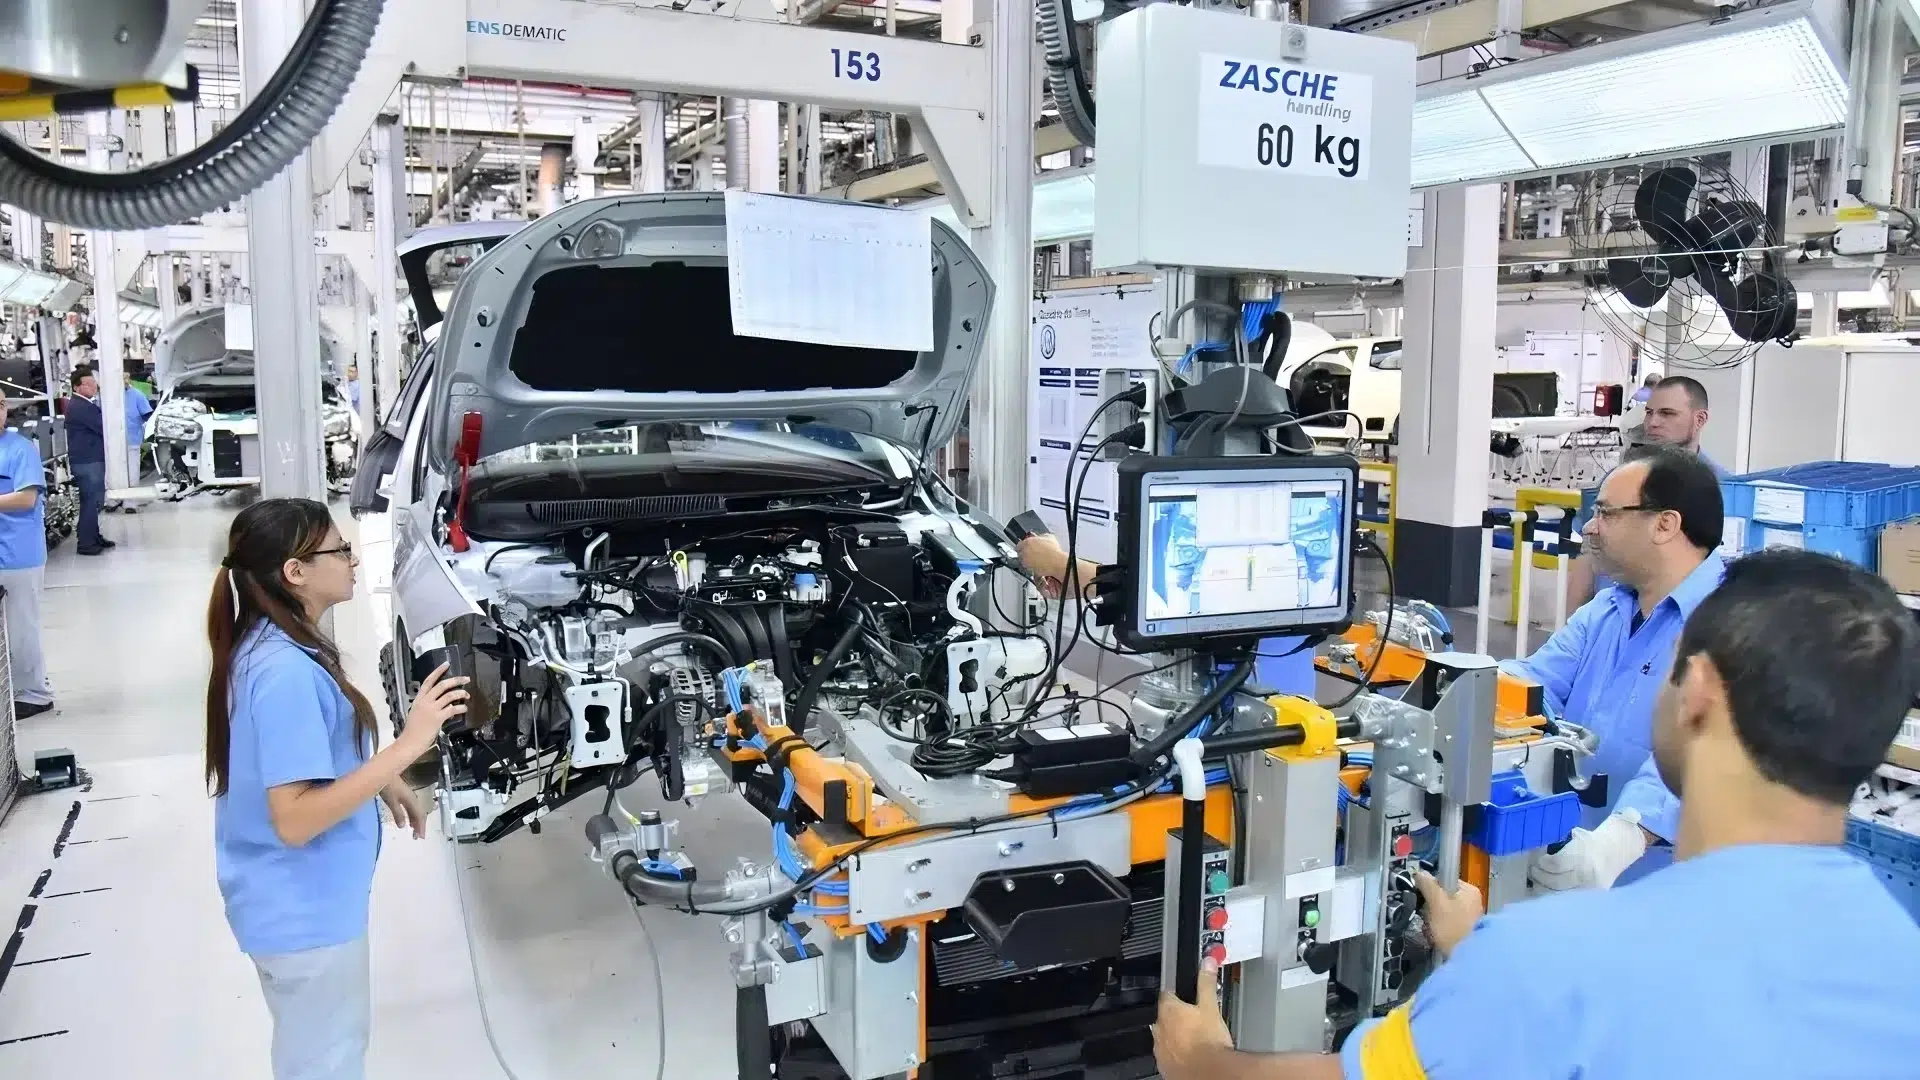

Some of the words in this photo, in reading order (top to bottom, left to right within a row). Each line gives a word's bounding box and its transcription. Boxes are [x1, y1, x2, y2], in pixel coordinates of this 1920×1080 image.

[502, 23, 567, 41] DEMATIC
[831, 48, 881, 82] 153
[1219, 60, 1339, 101] ZASCHE
[1286, 98, 1352, 123] handling
[1257, 122, 1294, 168] 60
[1314, 124, 1360, 178] kg
